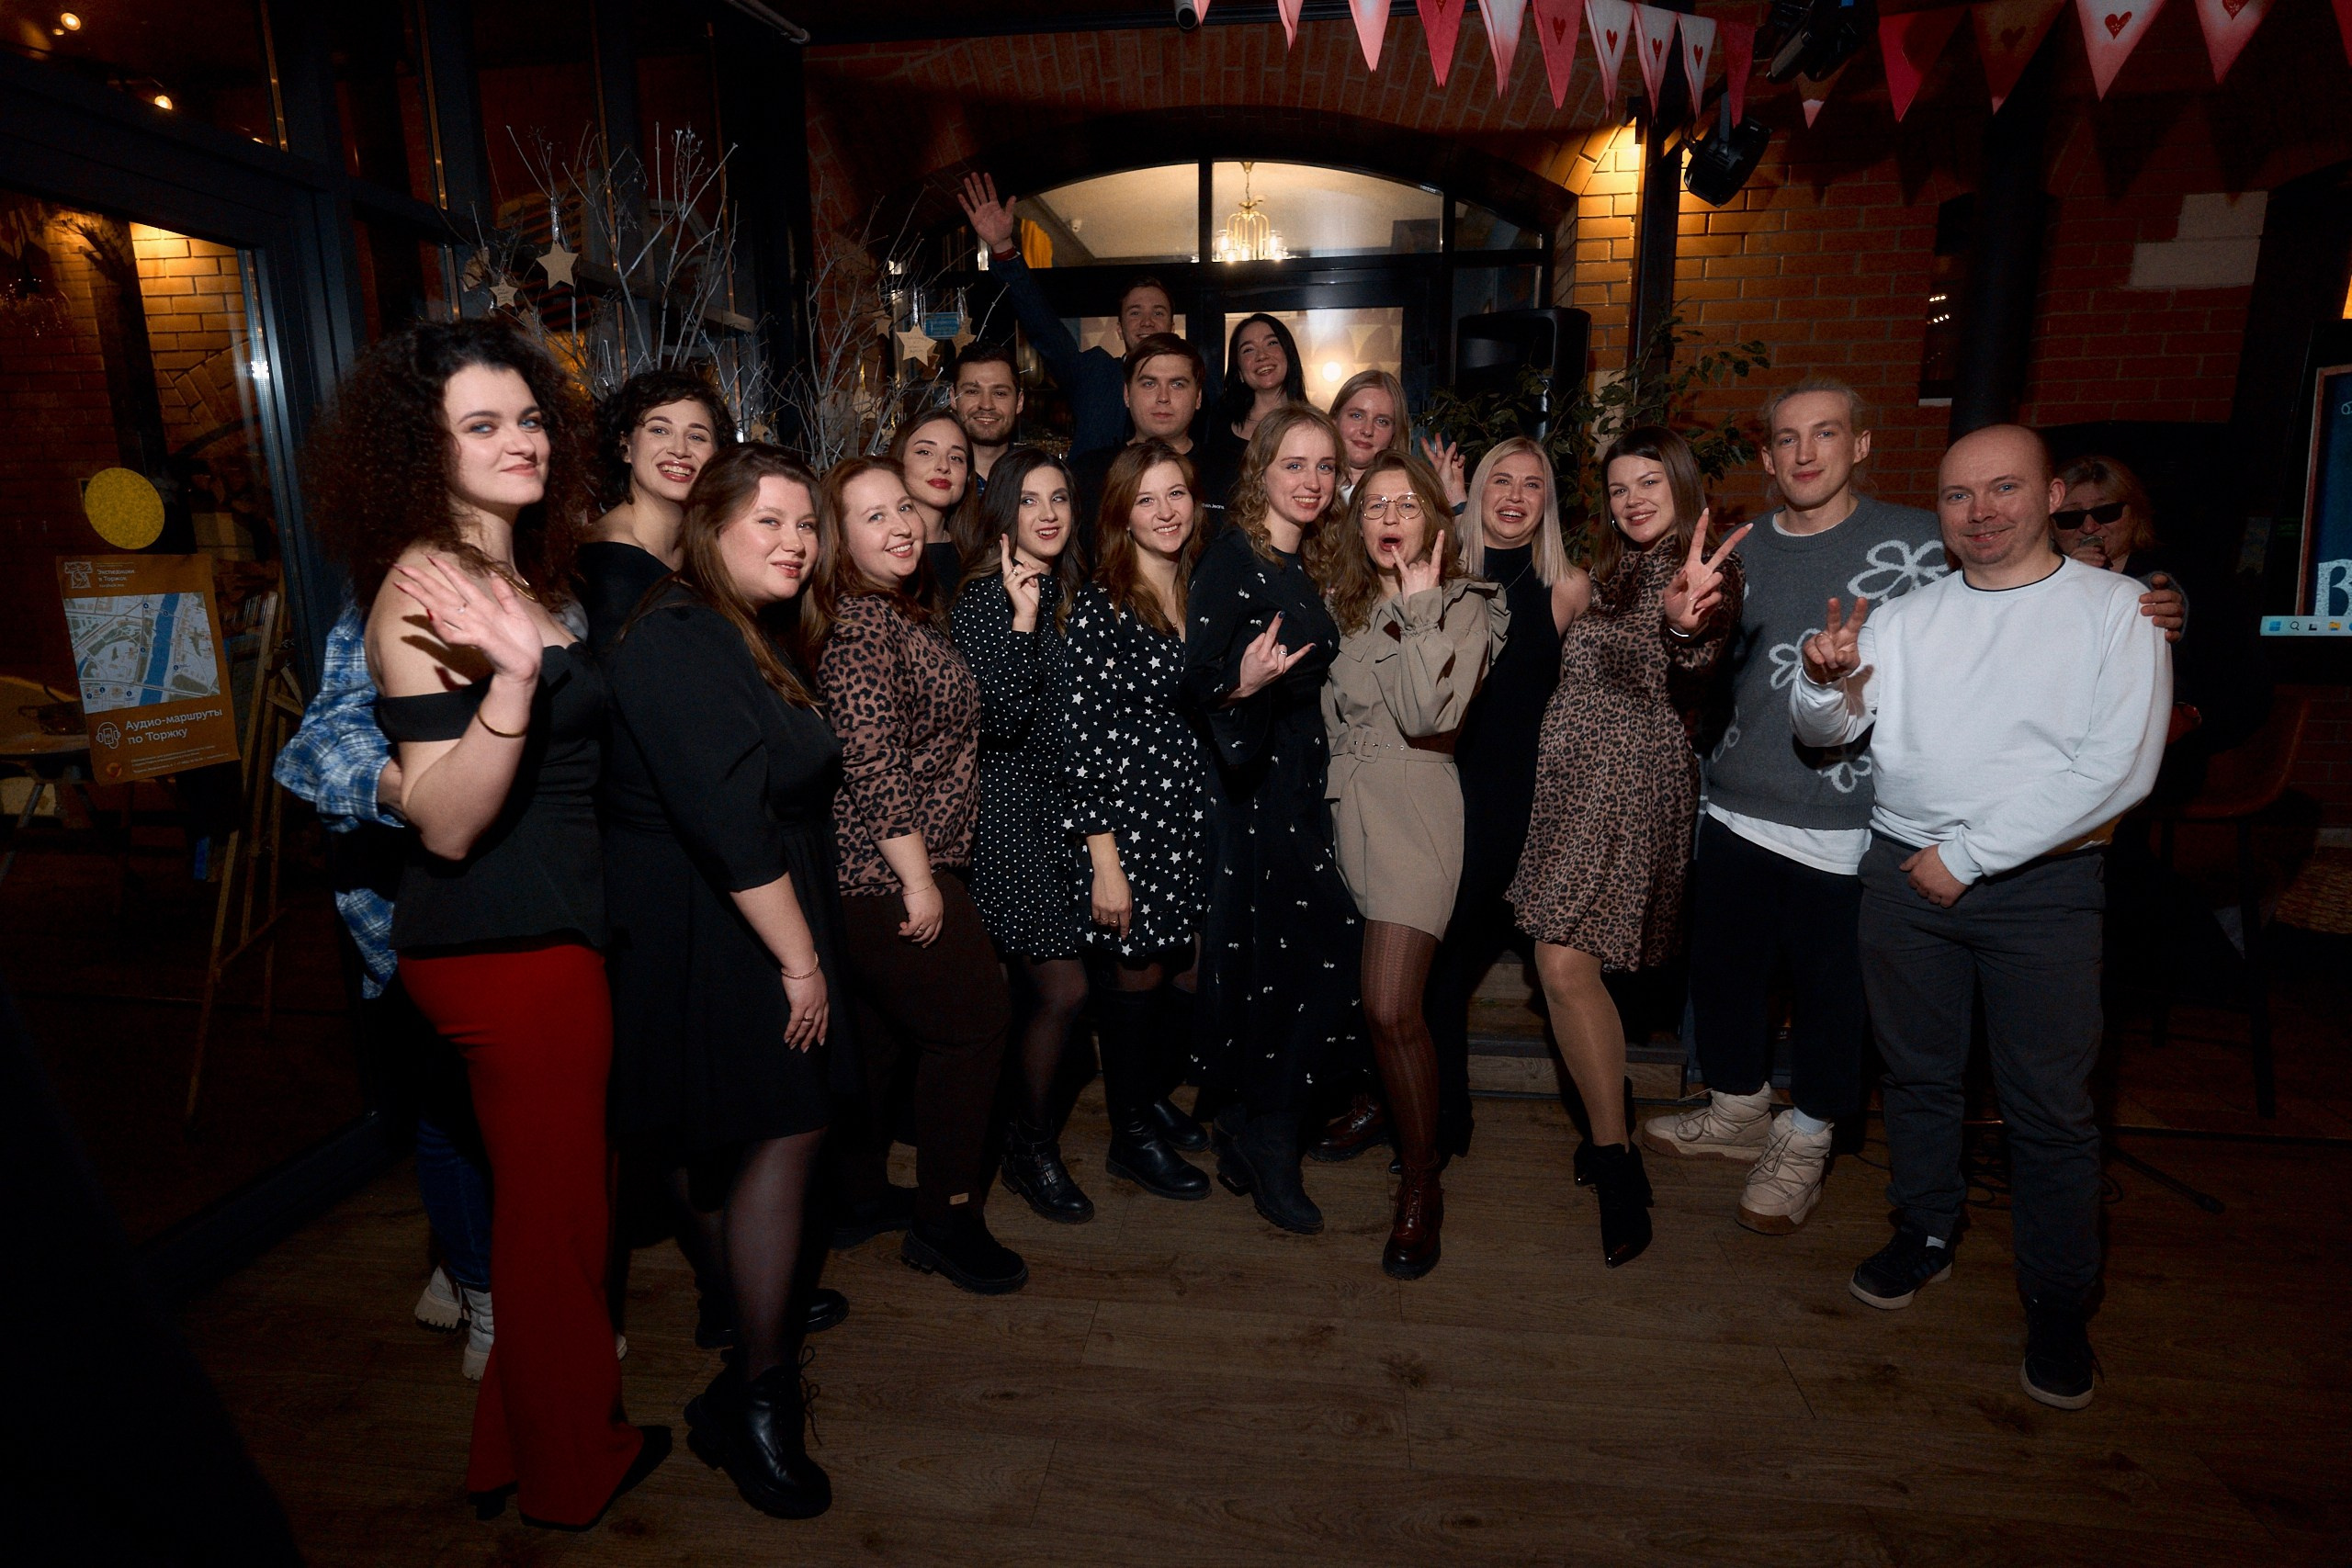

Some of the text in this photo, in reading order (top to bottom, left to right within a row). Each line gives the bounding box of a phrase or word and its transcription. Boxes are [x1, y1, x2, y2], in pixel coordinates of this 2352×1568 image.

[125, 708, 223, 731] Аудио-маршруты
[128, 728, 188, 745] по Торжку
